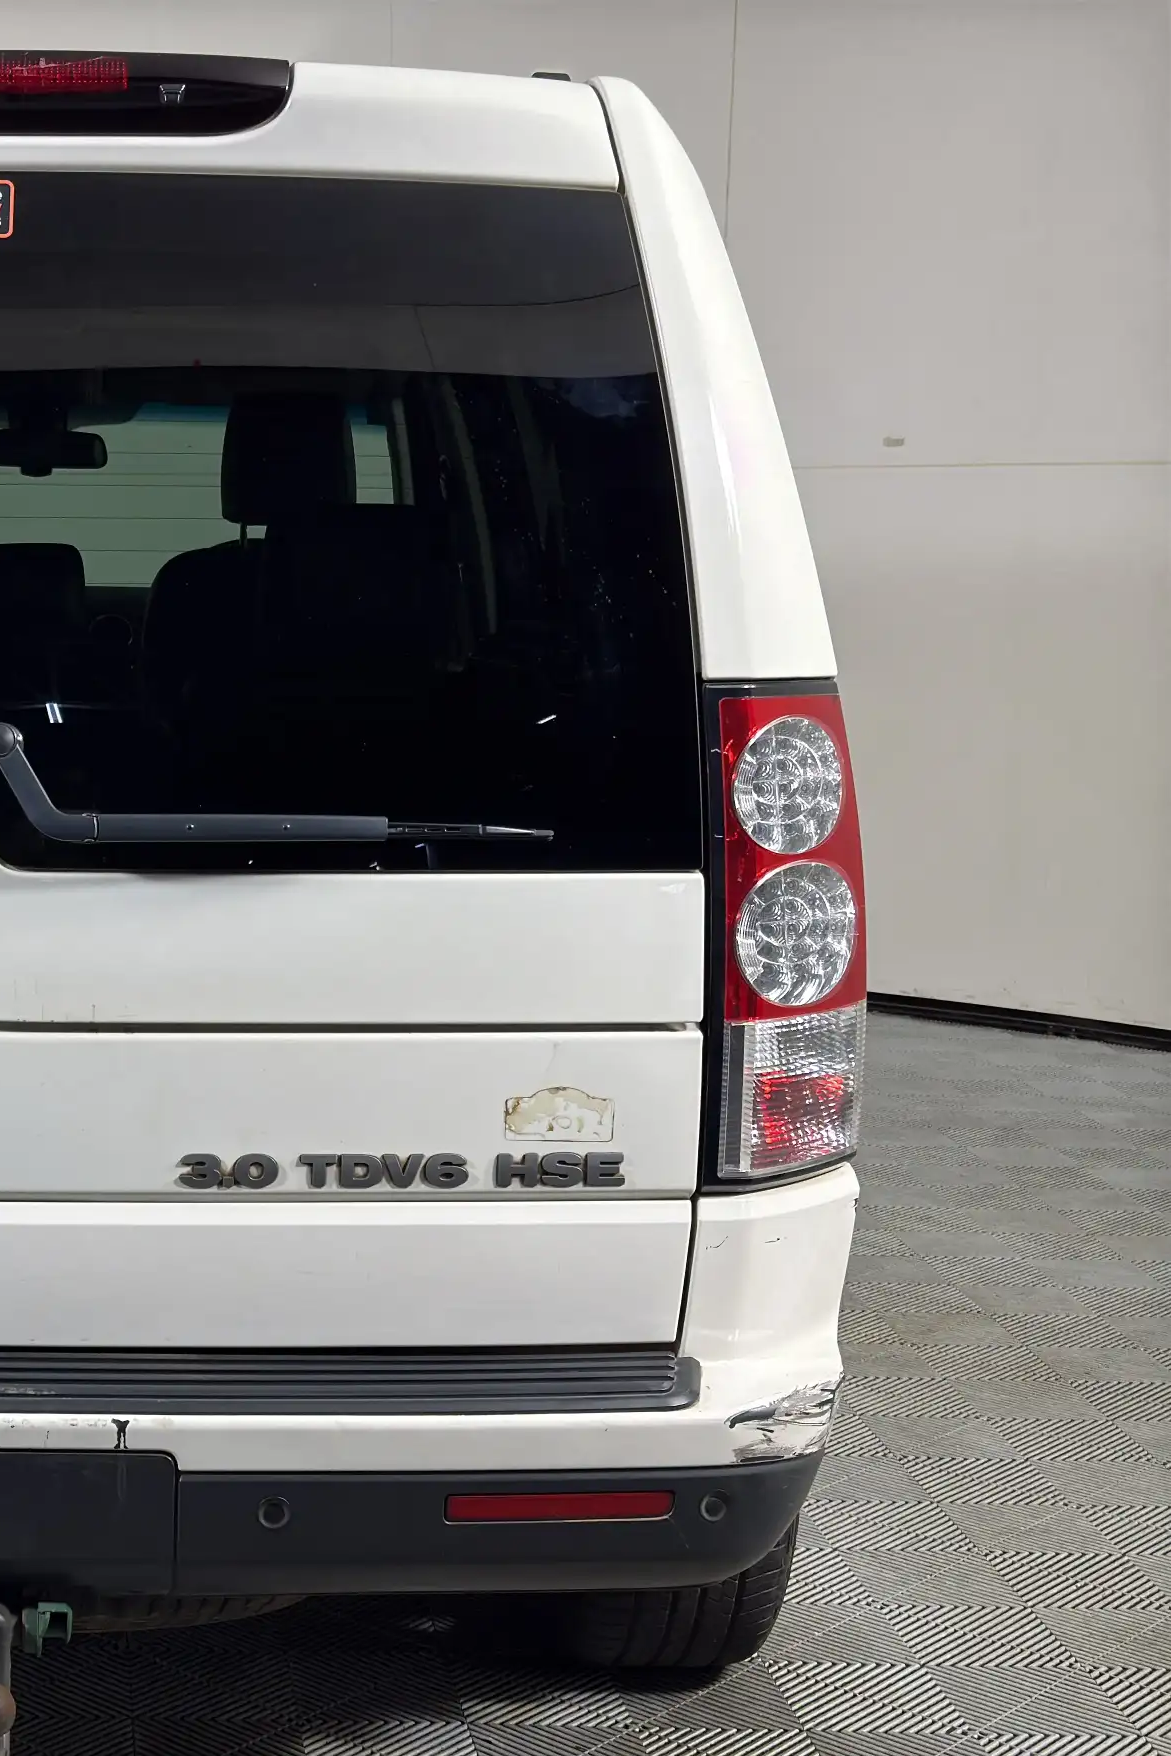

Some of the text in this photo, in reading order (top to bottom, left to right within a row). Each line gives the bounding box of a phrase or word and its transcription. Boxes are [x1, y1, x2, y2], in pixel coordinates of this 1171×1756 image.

[178, 1151, 626, 1190] 3.0 TDV6 HSE
